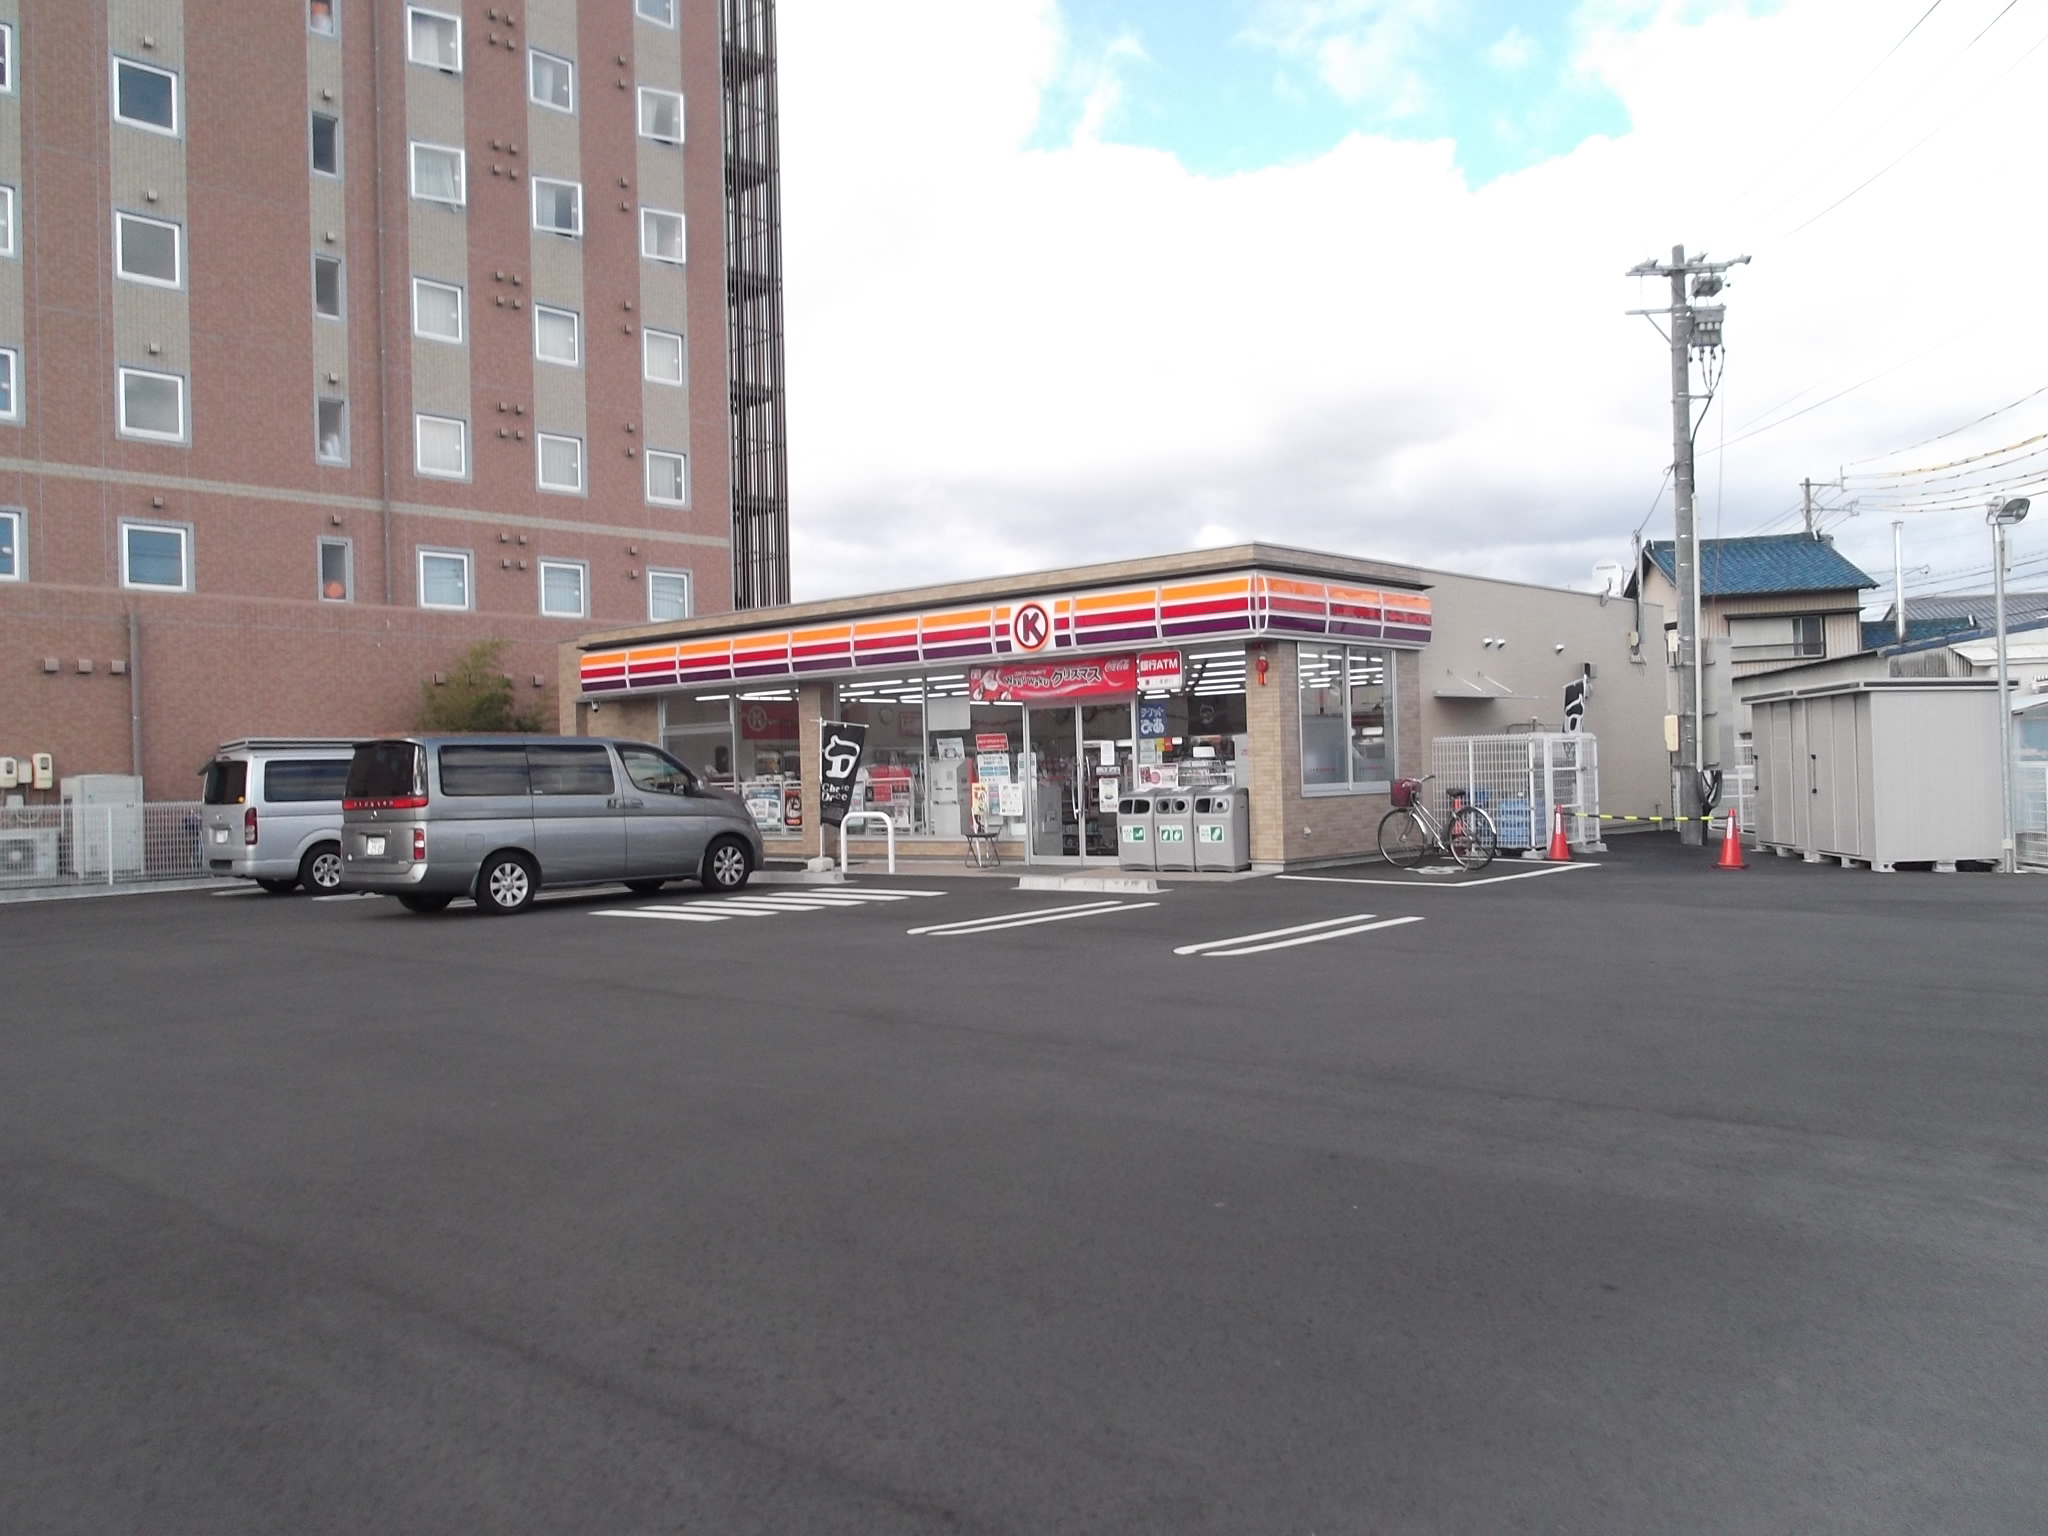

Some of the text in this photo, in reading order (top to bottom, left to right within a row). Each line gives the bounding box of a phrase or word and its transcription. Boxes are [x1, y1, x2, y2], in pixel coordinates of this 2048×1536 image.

[1021, 609, 1045, 646] K
[1140, 658, 1178, 671] 銀行ATM
[1051, 666, 1102, 688] クリスマス
[1140, 718, 1165, 735] ぴあ
